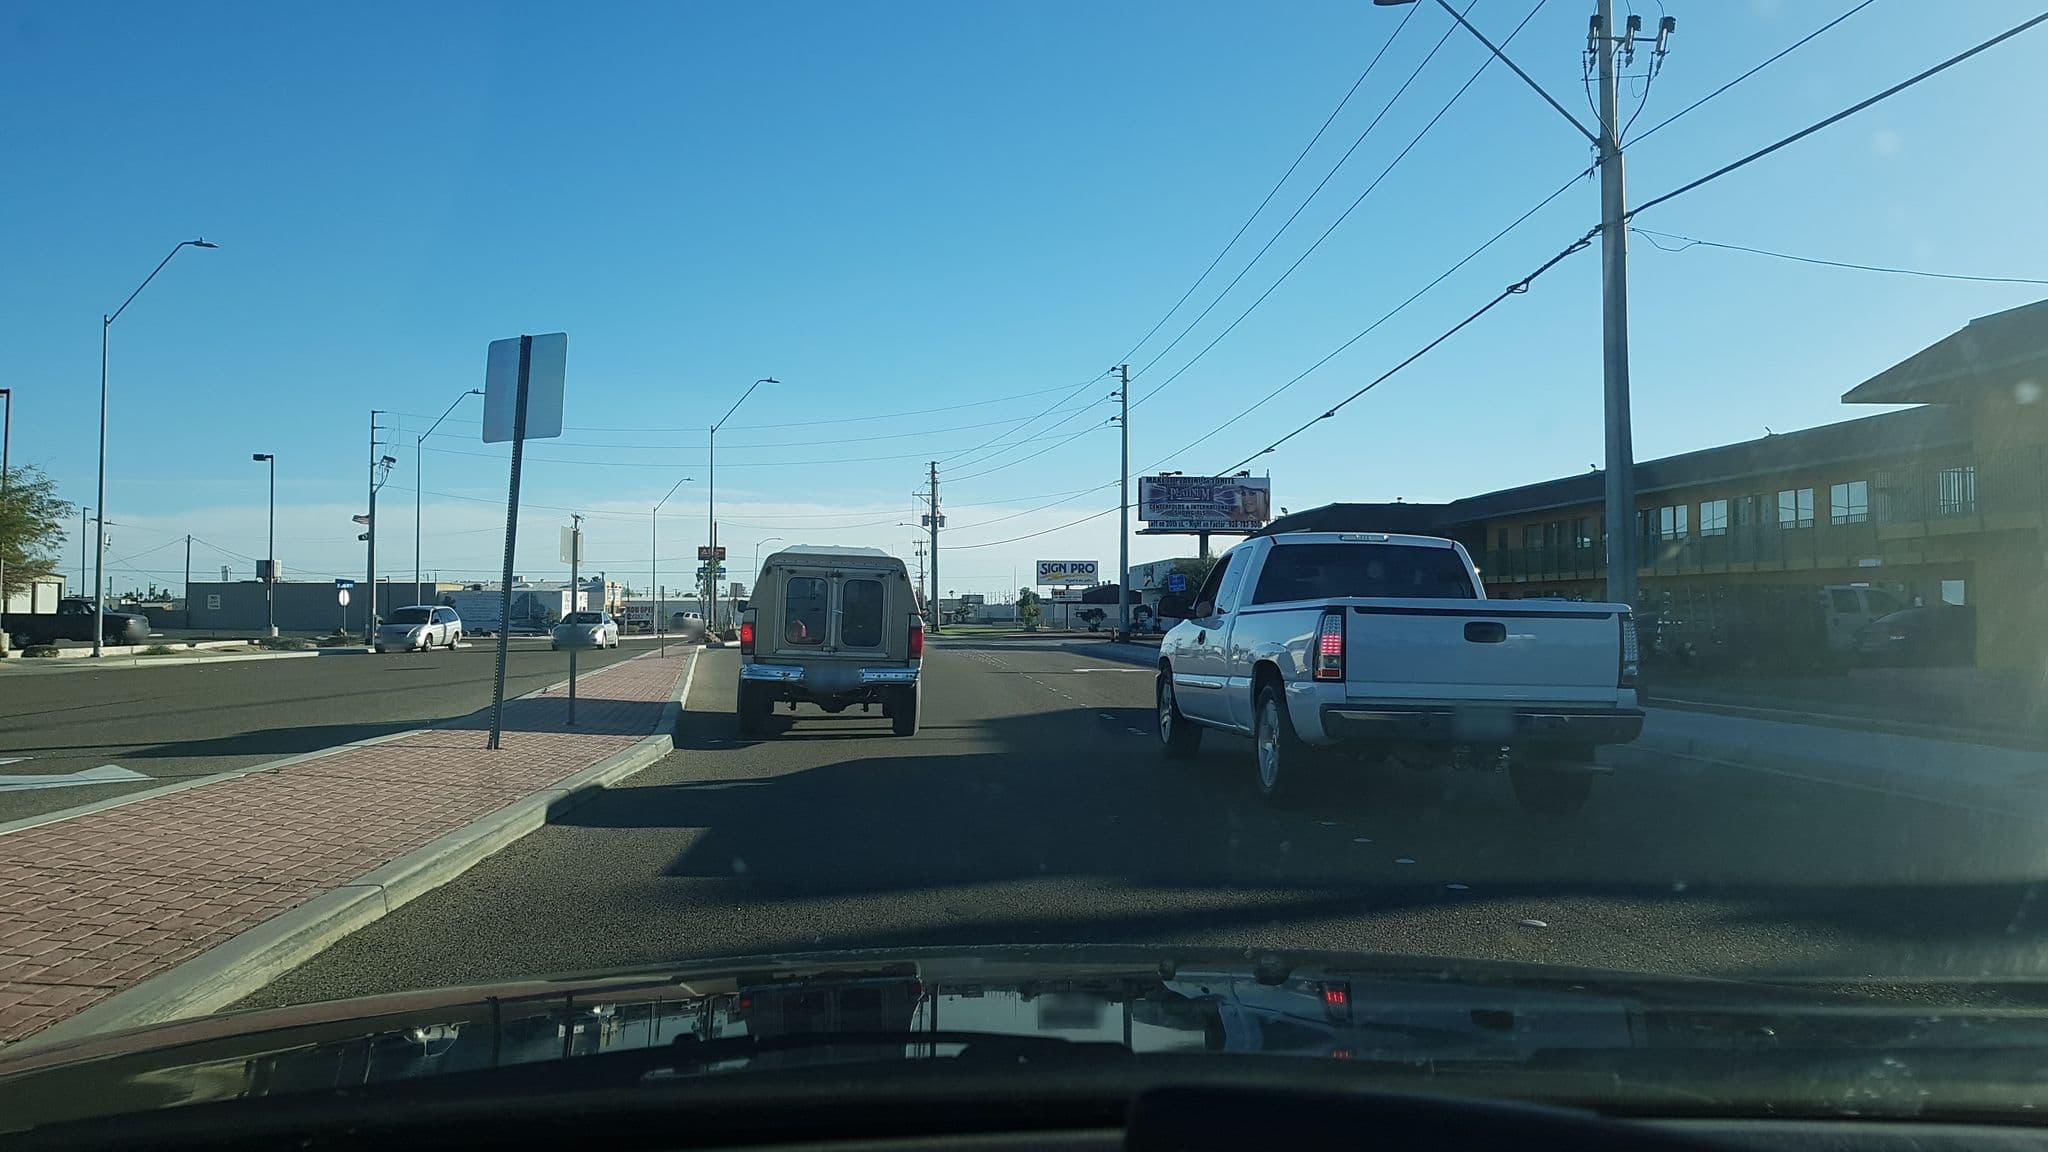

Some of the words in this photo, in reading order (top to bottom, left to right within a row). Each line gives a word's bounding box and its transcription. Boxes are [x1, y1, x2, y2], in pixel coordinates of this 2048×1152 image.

[1170, 487, 1210, 501] PLATINUM
[1040, 563, 1067, 574] SIGN
[1071, 563, 1095, 573] PRO
